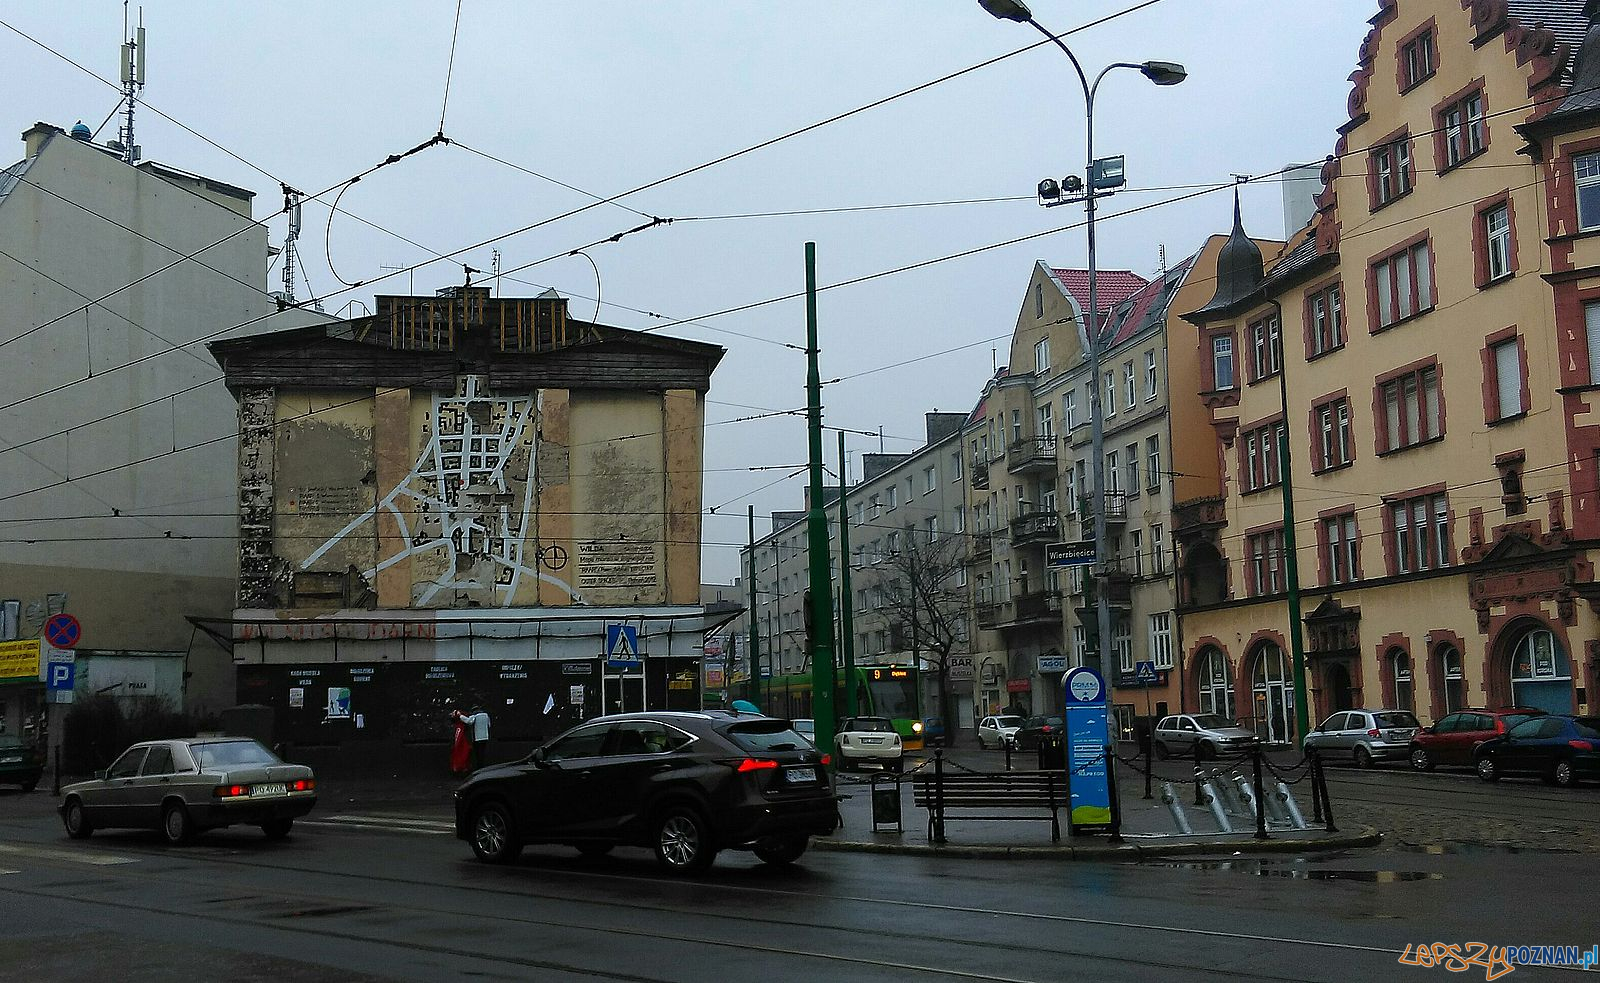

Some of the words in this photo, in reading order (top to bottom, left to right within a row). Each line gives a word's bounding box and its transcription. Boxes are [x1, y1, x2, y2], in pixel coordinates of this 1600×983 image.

[951, 658, 972, 667] BAR
[53, 665, 69, 687] P
[874, 669, 882, 680] 9
